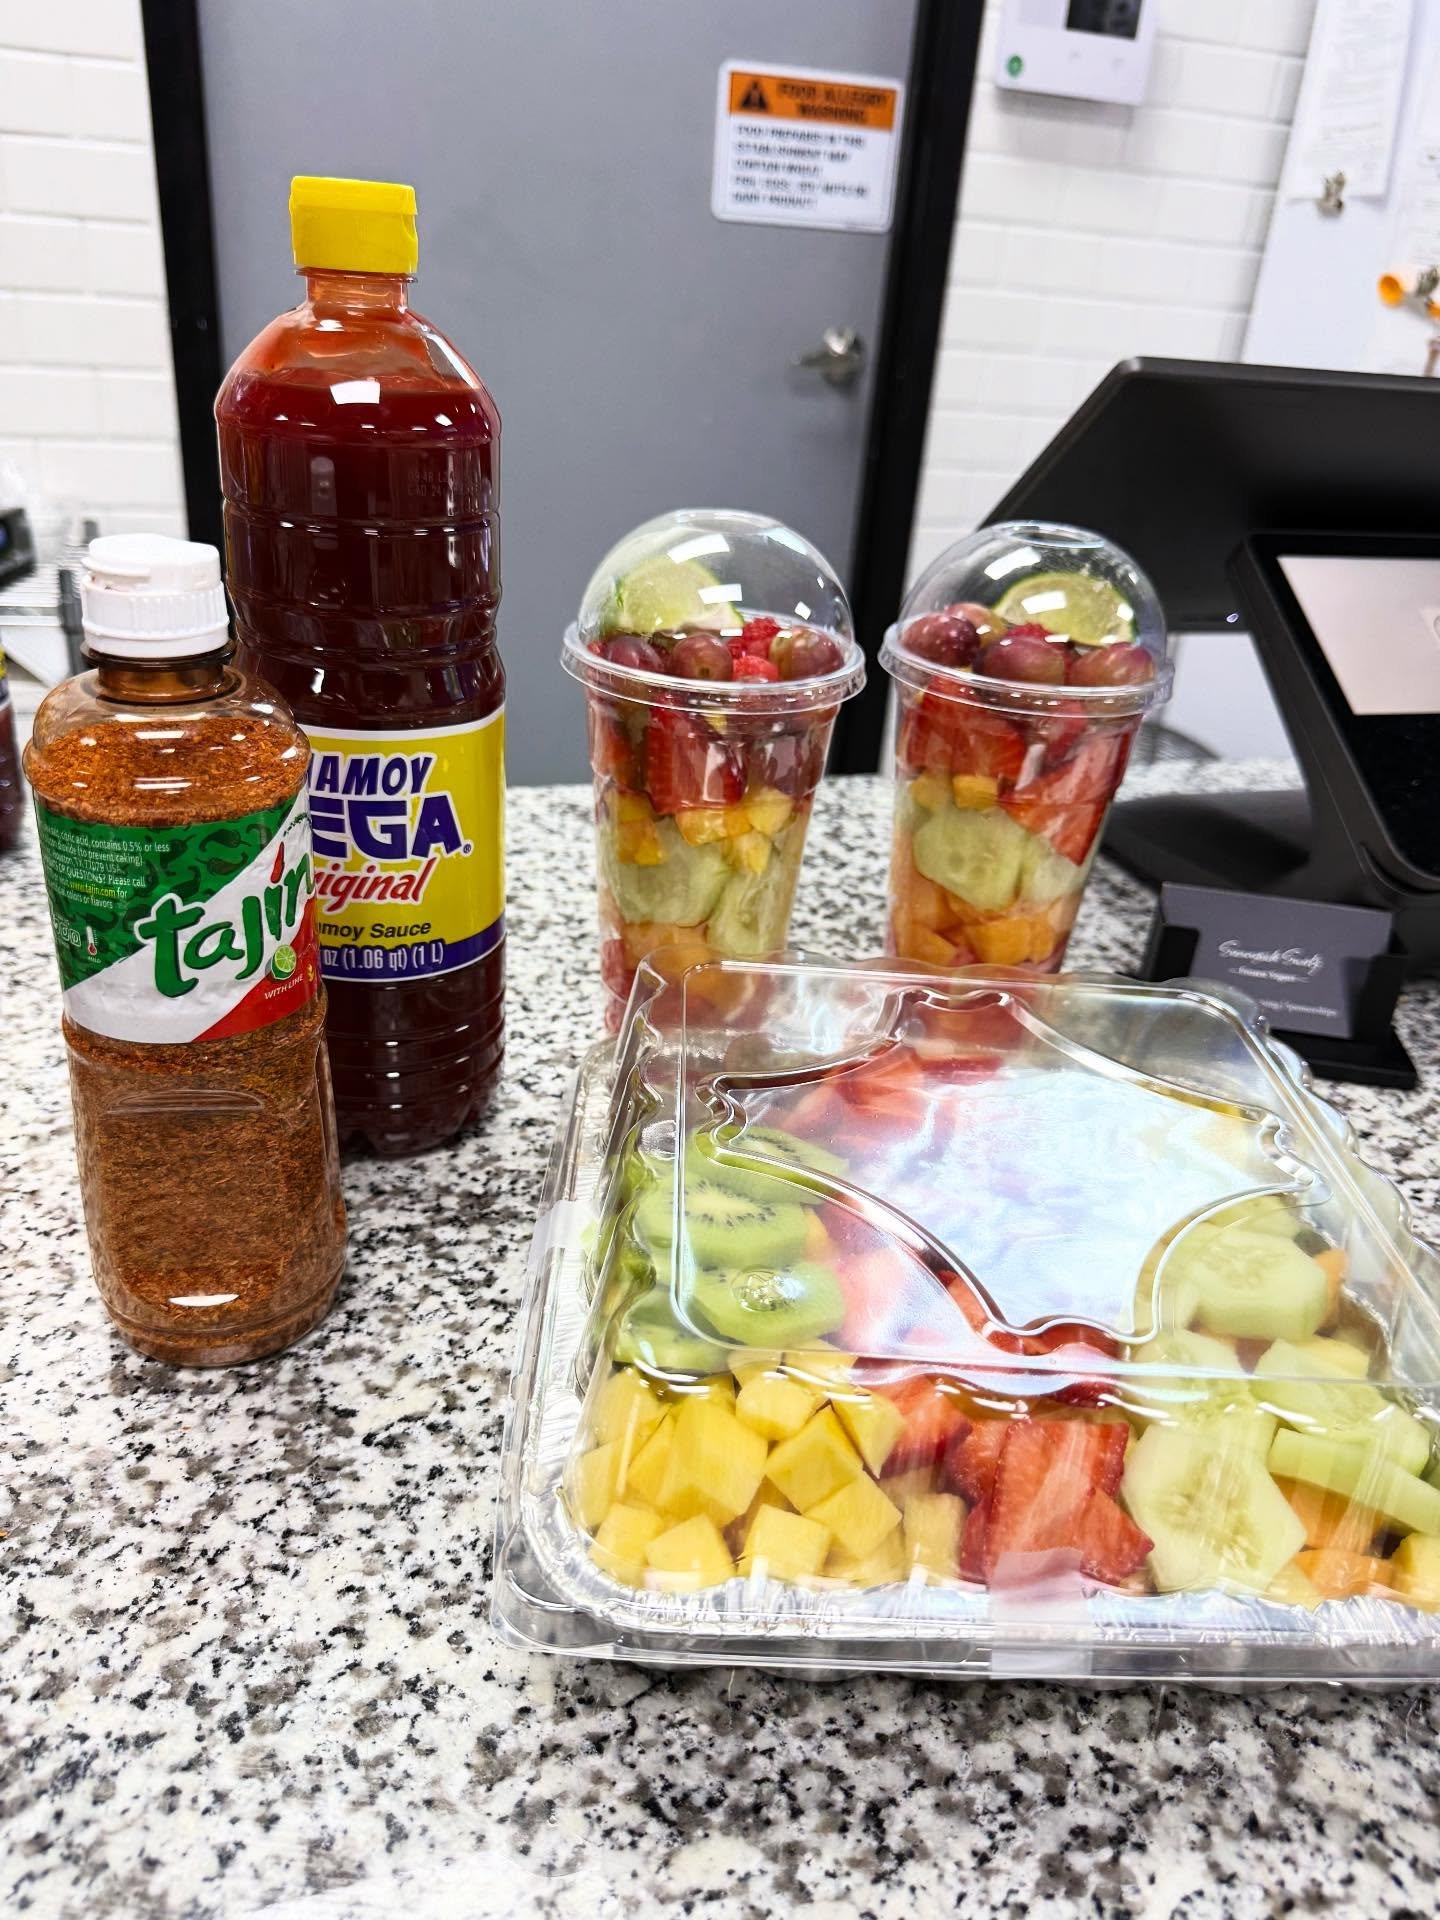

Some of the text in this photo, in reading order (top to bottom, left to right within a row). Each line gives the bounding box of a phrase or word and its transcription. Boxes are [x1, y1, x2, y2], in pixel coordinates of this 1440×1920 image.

[308, 753, 433, 797] AMOY
[91, 840, 121, 852] contains
[122, 841, 142, 853] 0.5%
[144, 844, 153, 853] or
[154, 842, 171, 853] less
[88, 850, 114, 863] prevent
[66, 865, 107, 884] QUESTIONS?
[108, 874, 131, 887] Please
[132, 876, 146, 888] call
[314, 856, 438, 913] riginal
[117, 886, 129, 899] for
[90, 895, 114, 909] flavors
[318, 922, 432, 941] moy Sauce
[342, 947, 385, 971] (1.06
[389, 947, 408, 972] qt)
[412, 944, 425, 969] (1
[431, 941, 444, 965] L)
[264, 983, 288, 1000] WITH
